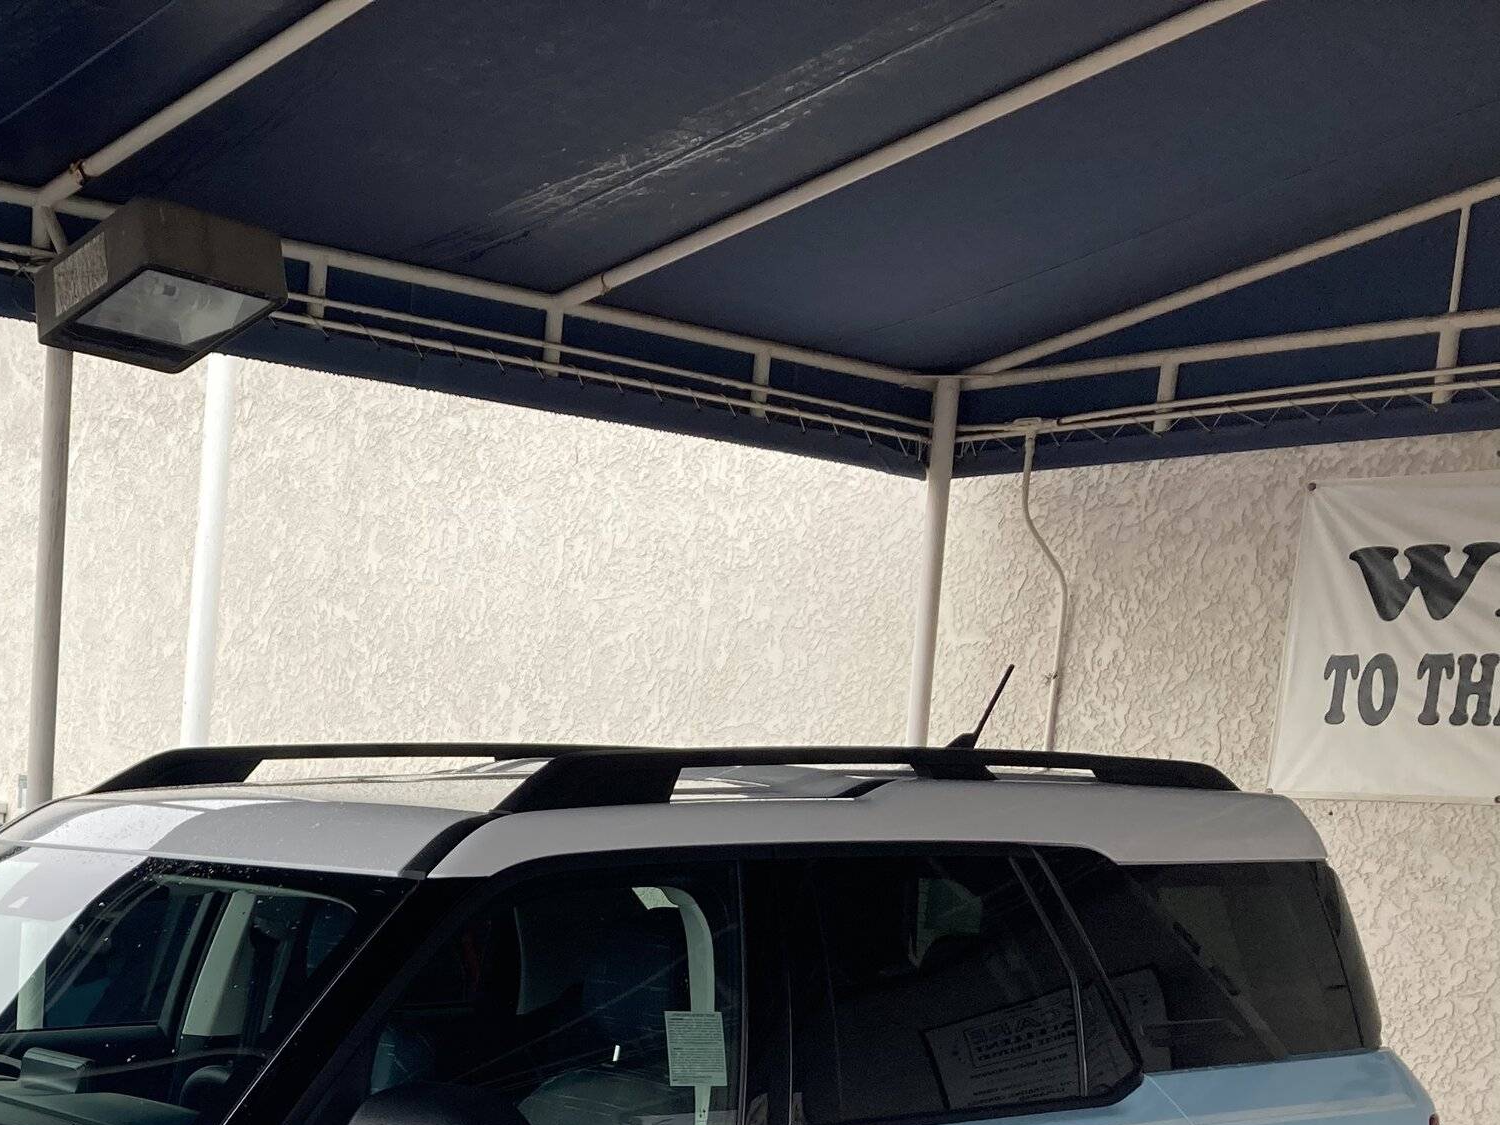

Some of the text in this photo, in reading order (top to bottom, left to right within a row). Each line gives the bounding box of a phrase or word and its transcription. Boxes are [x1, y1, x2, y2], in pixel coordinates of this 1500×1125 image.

[1349, 541, 1500, 621] W
[1324, 653, 1500, 726] TO TH
